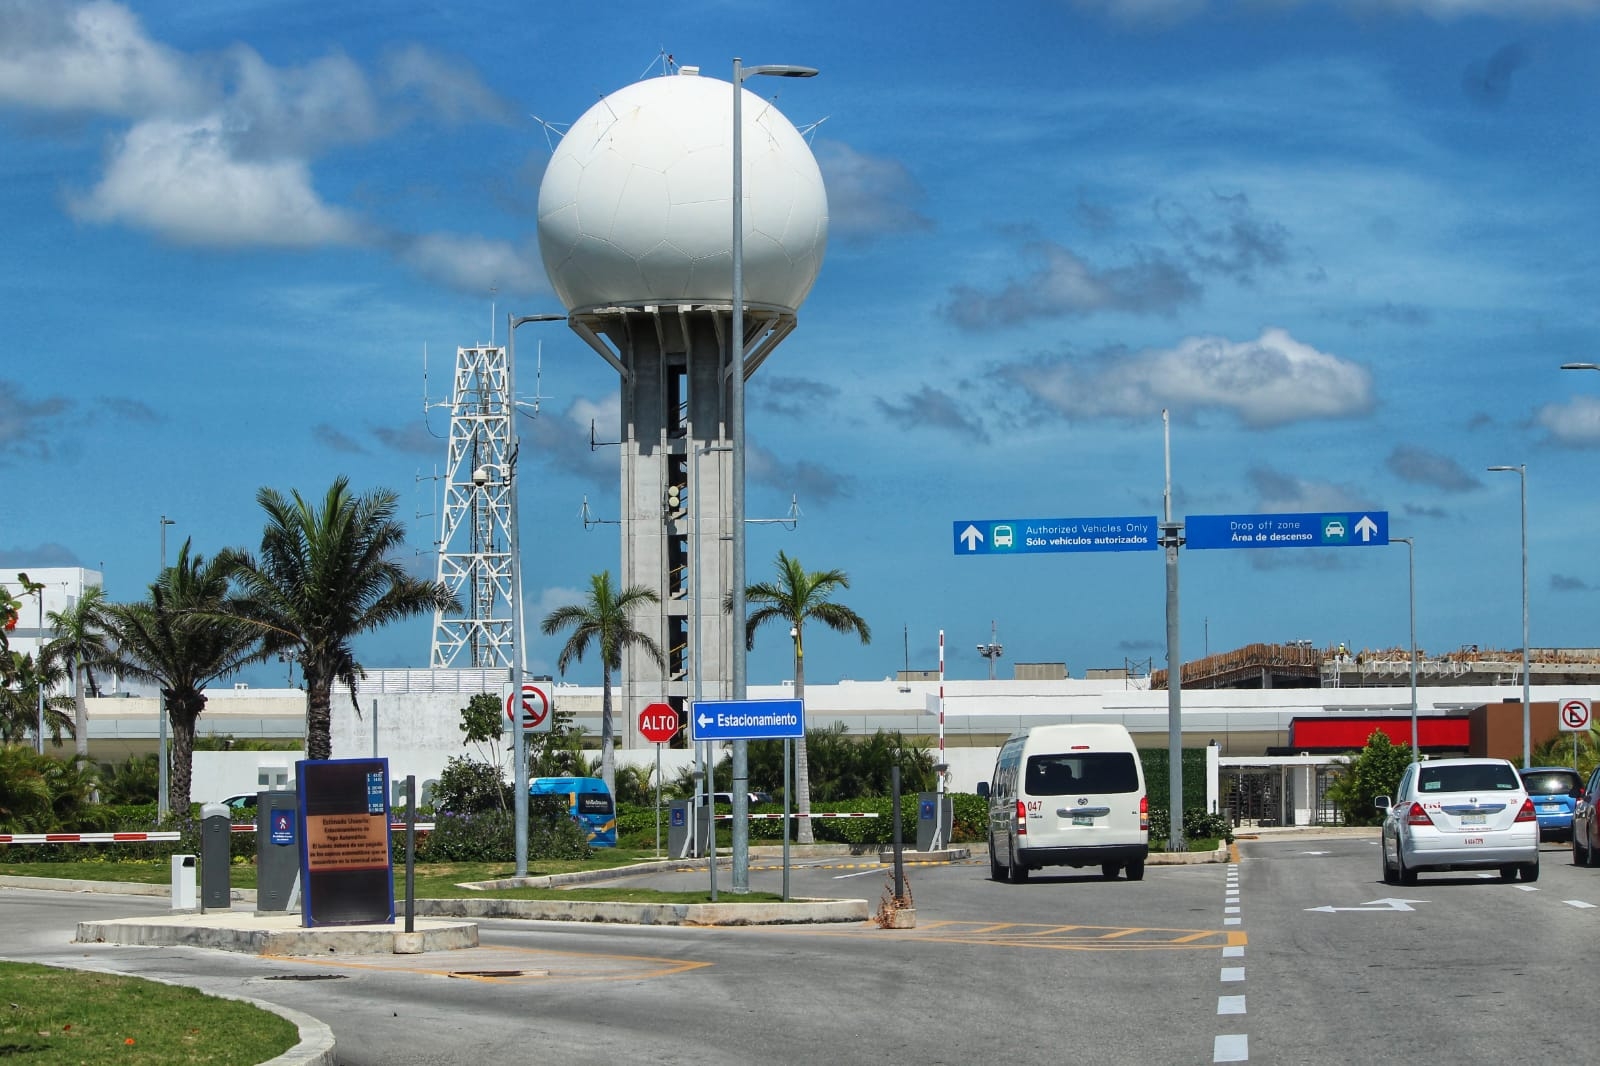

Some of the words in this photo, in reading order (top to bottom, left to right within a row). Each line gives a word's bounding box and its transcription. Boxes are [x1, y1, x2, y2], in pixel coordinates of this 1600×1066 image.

[1025, 524, 1078, 534] Authorized
[1081, 523, 1122, 533] Vehicles
[1126, 523, 1148, 533] Only
[1230, 521, 1254, 531] Drop
[1258, 520, 1273, 529] off
[1277, 521, 1301, 529] zone
[1025, 535, 1047, 546] Sólo
[1094, 535, 1148, 545] autorizados
[1231, 532, 1253, 542] Área
[1255, 533, 1268, 541] de
[1270, 532, 1313, 541] descenso
[641, 715, 675, 731] ALTO
[717, 712, 797, 727] Estacionamiento
[1027, 800, 1043, 811] 047
